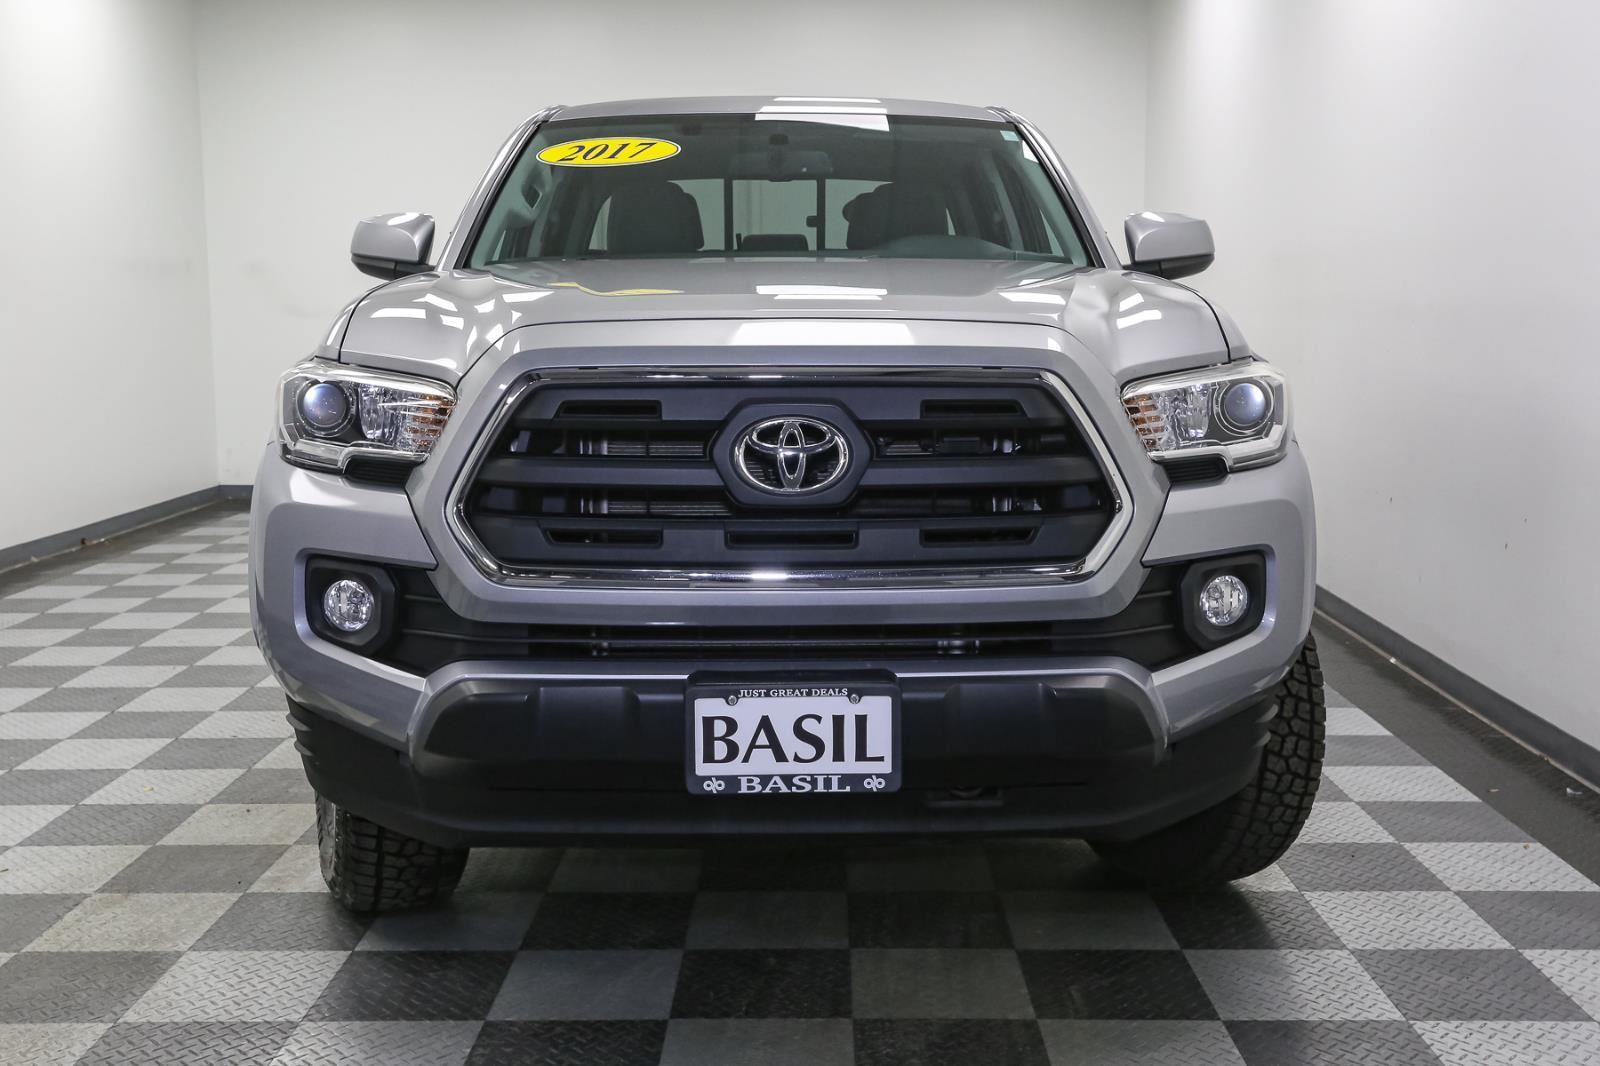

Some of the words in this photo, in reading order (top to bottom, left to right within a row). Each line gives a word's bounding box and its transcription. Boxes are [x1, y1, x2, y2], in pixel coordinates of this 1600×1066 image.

[557, 142, 657, 162] 2017
[738, 689, 767, 698] JUST
[769, 688, 809, 697] GREAT
[811, 687, 848, 696] DEALS
[702, 713, 885, 764] BASIL
[737, 775, 851, 793] BASIL
